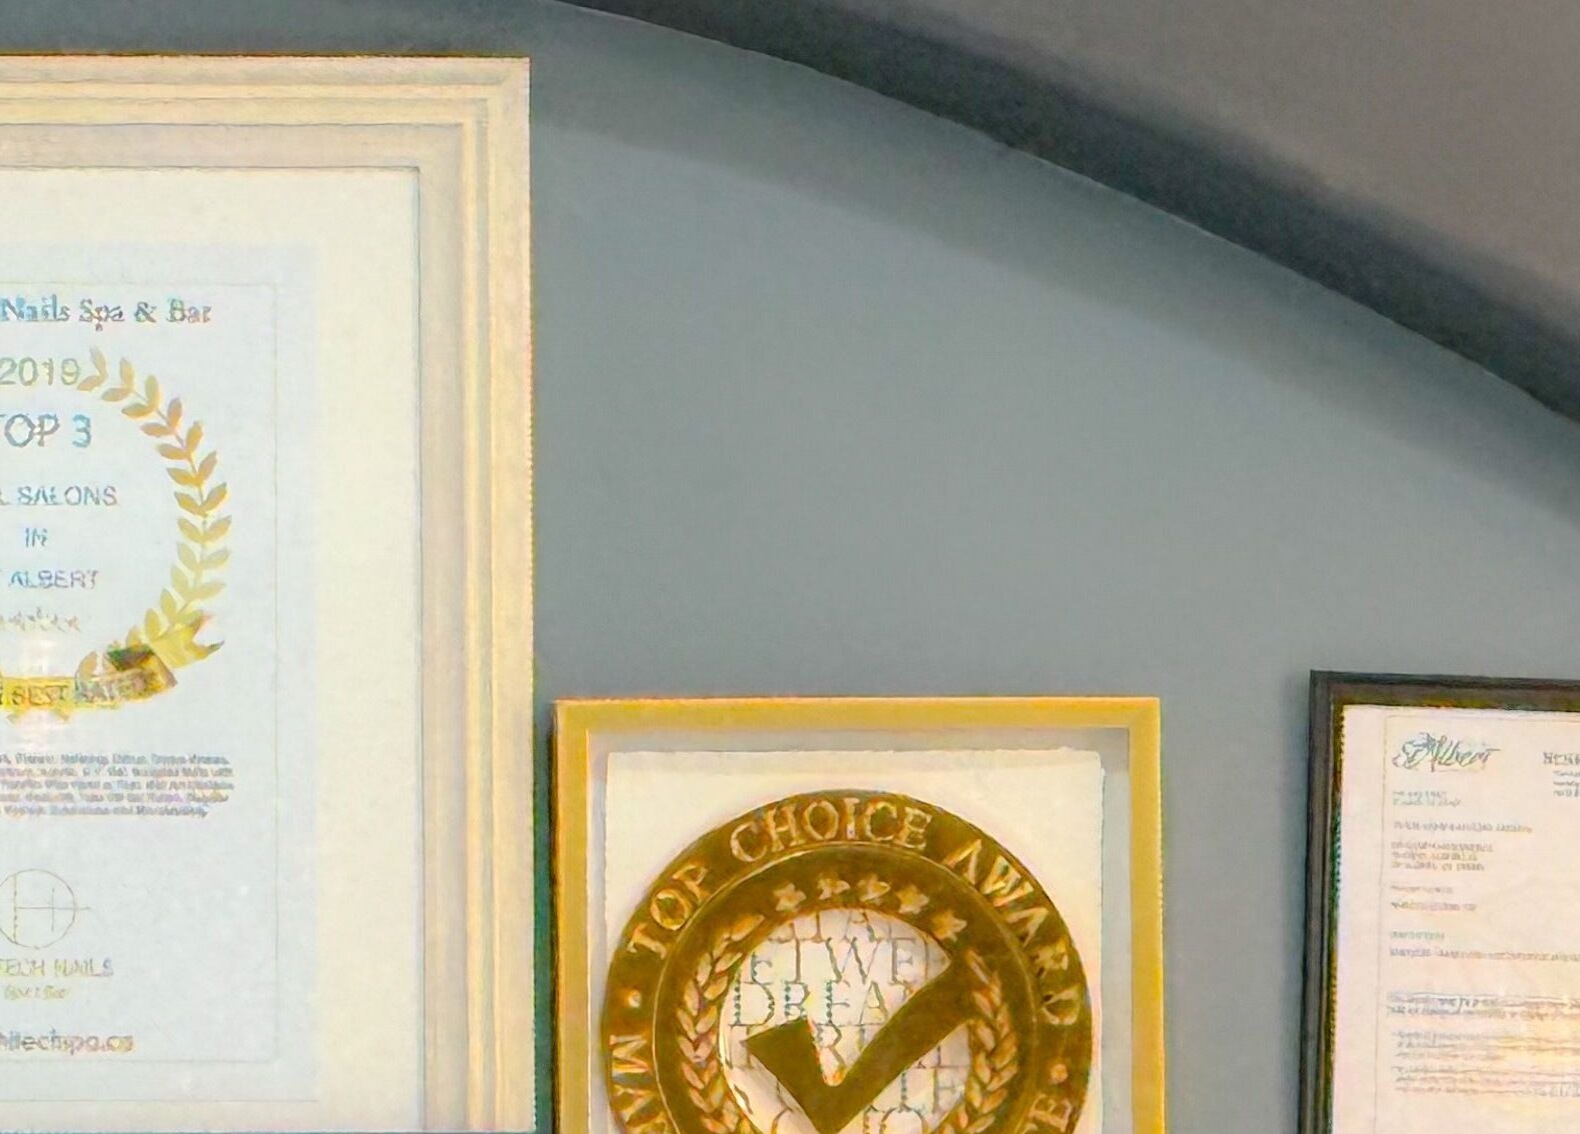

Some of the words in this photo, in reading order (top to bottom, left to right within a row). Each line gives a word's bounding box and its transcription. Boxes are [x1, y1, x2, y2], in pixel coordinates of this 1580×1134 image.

[0, 295, 71, 323] Nails
[78, 298, 124, 332] Spa
[133, 299, 158, 324] &
[169, 298, 214, 324] Bar
[72, 413, 93, 448] 3
[17, 485, 119, 507] SALONS
[7, 569, 100, 590] ALBERT
[625, 862, 711, 959] TOP
[729, 796, 932, 863] CHOICE
[943, 837, 1083, 1026] AWARD
